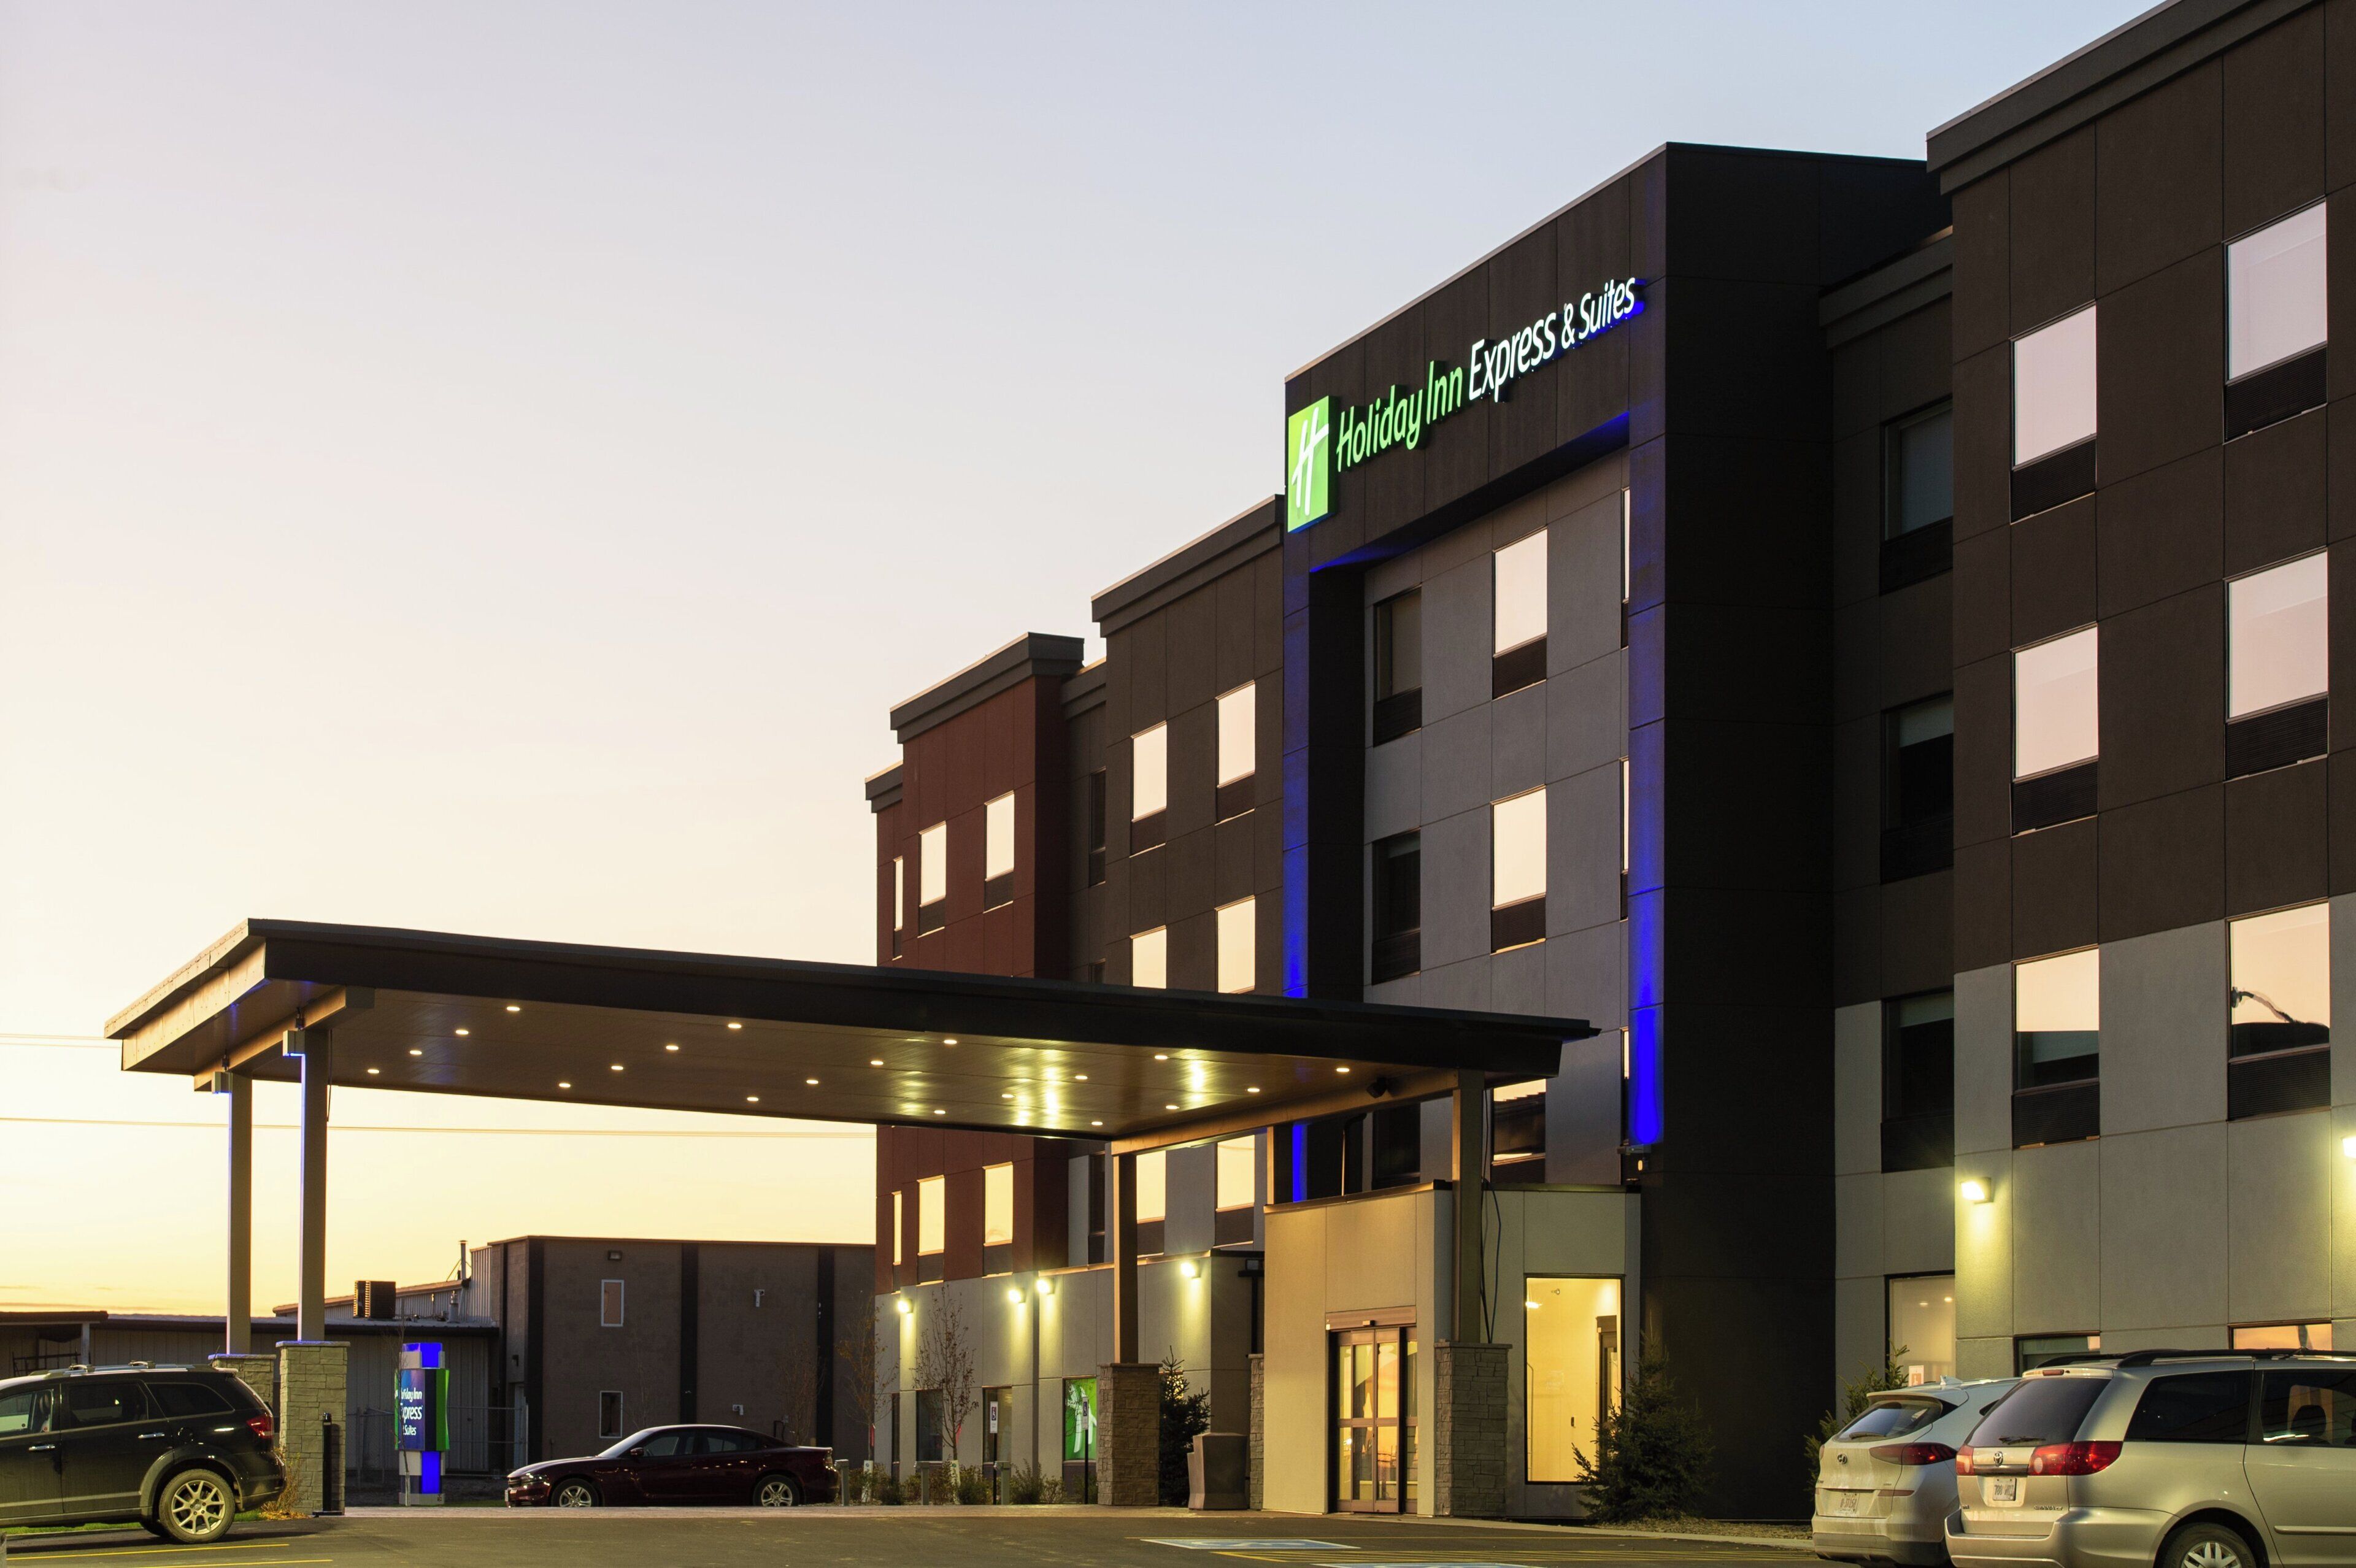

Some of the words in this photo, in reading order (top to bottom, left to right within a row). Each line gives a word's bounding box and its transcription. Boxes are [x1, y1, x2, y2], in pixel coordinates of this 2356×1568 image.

[1336, 384, 1423, 472] Holiday
[1426, 360, 1463, 425] Inn
[1469, 312, 1557, 402] Express
[1561, 303, 1576, 349] &
[1579, 277, 1635, 339] Suites
[414, 1387, 423, 1399] Inn
